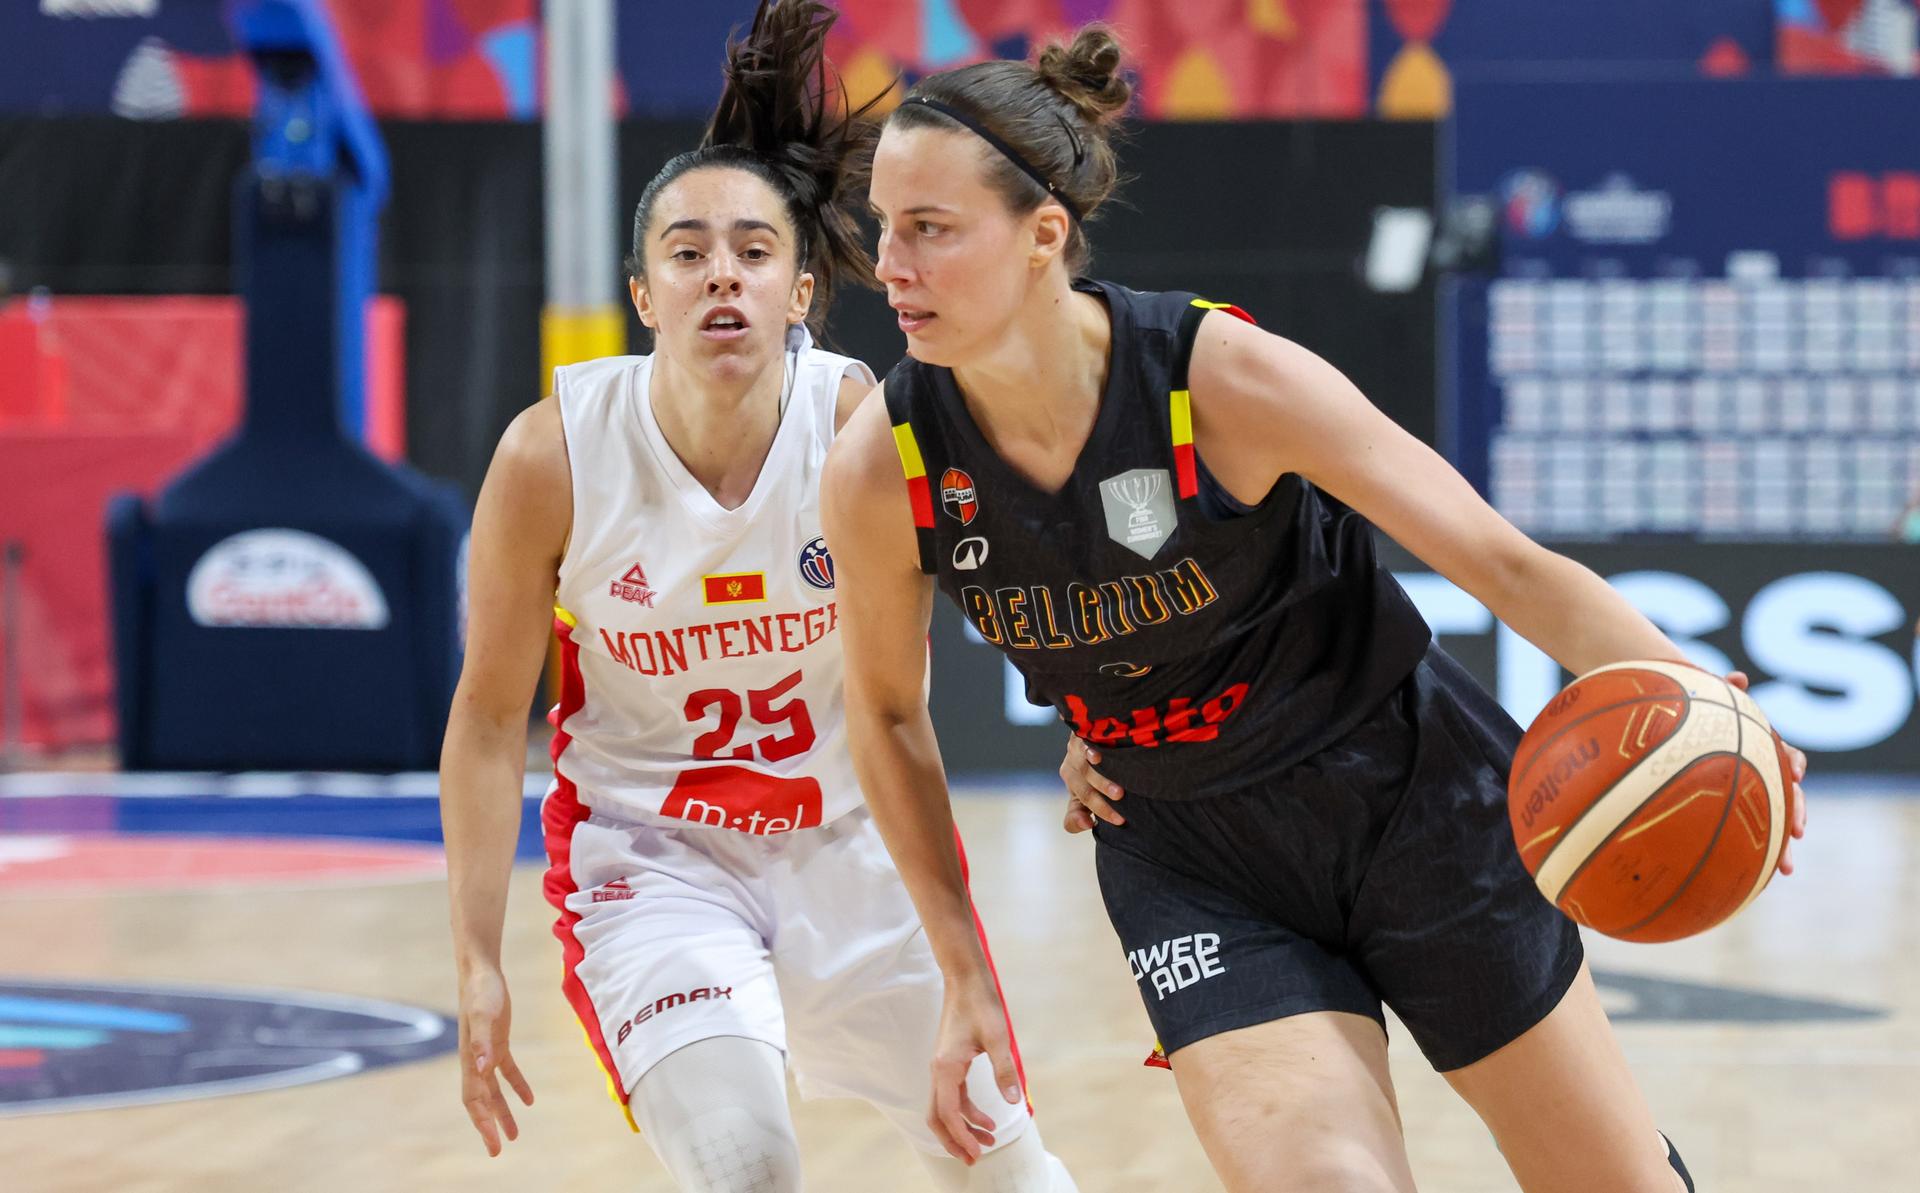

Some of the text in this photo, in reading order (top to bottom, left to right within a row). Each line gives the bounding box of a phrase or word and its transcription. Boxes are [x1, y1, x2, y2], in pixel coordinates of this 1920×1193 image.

[609, 580, 658, 609] PEAK
[962, 557, 1219, 649] BELGIUM
[683, 669, 816, 763] 25
[1151, 946, 1226, 1001] ADE
